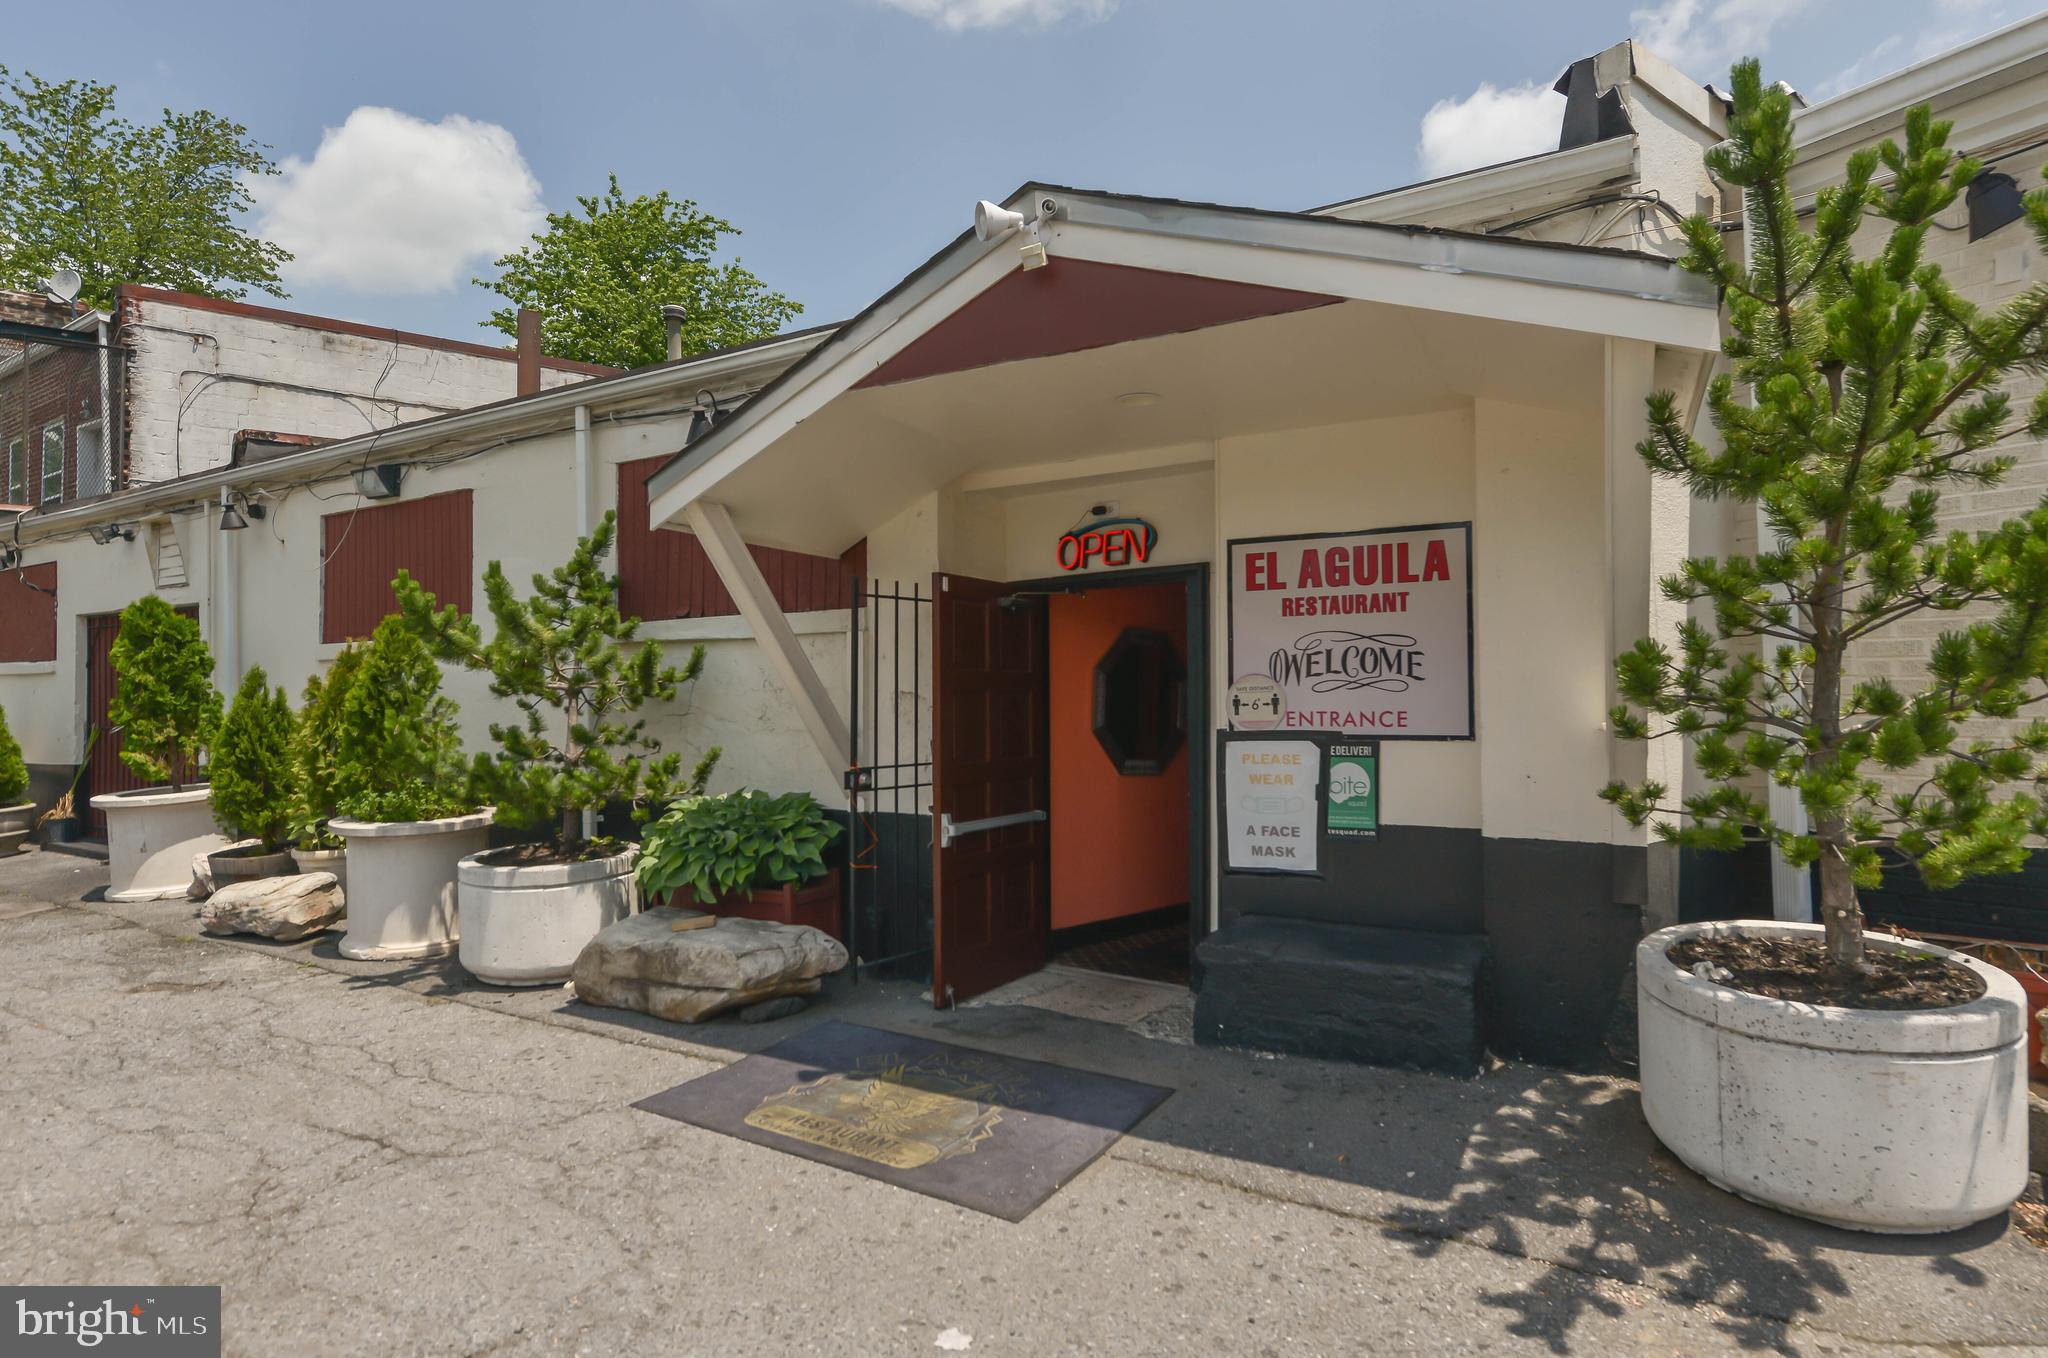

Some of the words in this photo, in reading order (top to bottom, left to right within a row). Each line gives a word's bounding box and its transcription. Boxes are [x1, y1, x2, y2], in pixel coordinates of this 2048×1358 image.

[1056, 527, 1148, 571] OPEN
[1245, 551, 1287, 591] EL
[1297, 540, 1450, 589] AGUILA
[1281, 591, 1409, 617] RESTAURANT
[1269, 645, 1426, 688] WELCOME
[1286, 711, 1408, 728] ENTRANCE
[1241, 753, 1302, 766] PLEASE
[1249, 774, 1294, 785] WEAR
[1246, 824, 1256, 836] A
[1261, 825, 1301, 838] FACE
[1251, 845, 1296, 858] MASK
